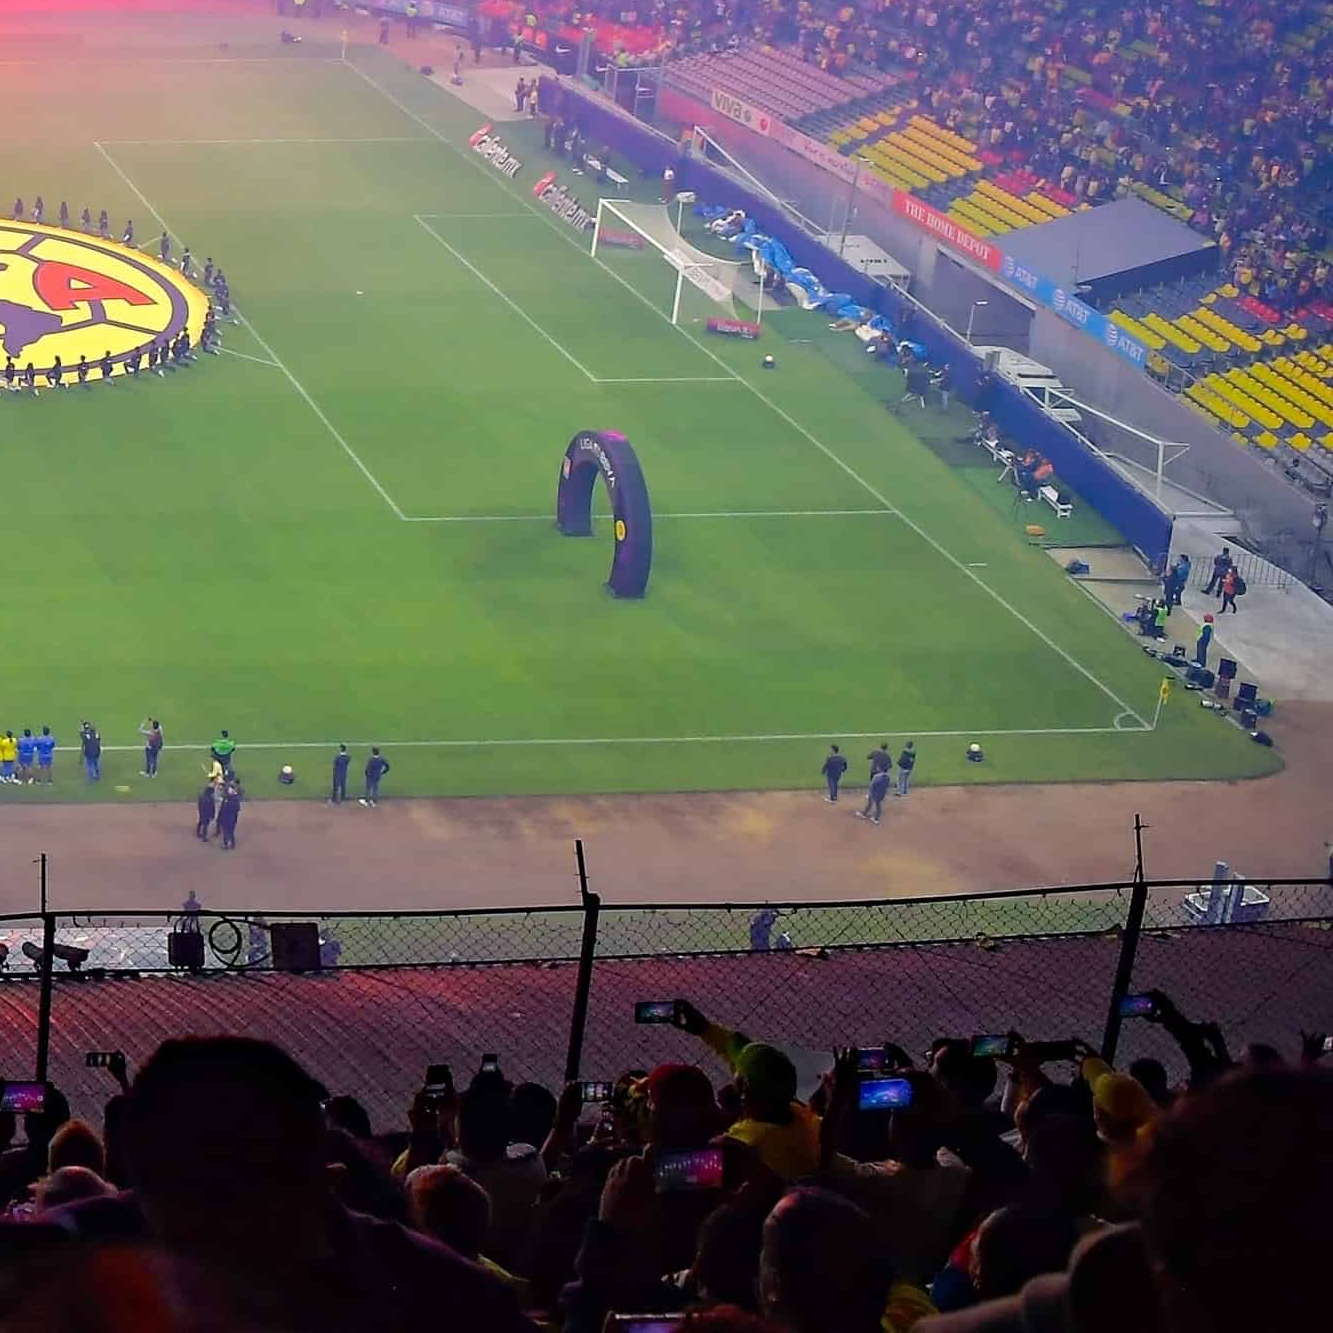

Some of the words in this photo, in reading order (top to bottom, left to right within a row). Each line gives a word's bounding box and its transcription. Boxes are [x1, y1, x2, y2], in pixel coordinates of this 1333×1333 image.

[903, 200, 925, 221] THE
[926, 213, 956, 242] HOME
[956, 228, 991, 261] DEPOT
[1015, 265, 1041, 290] AT&T
[1064, 299, 1090, 323] AT&T
[1116, 337, 1146, 363] AT&T
